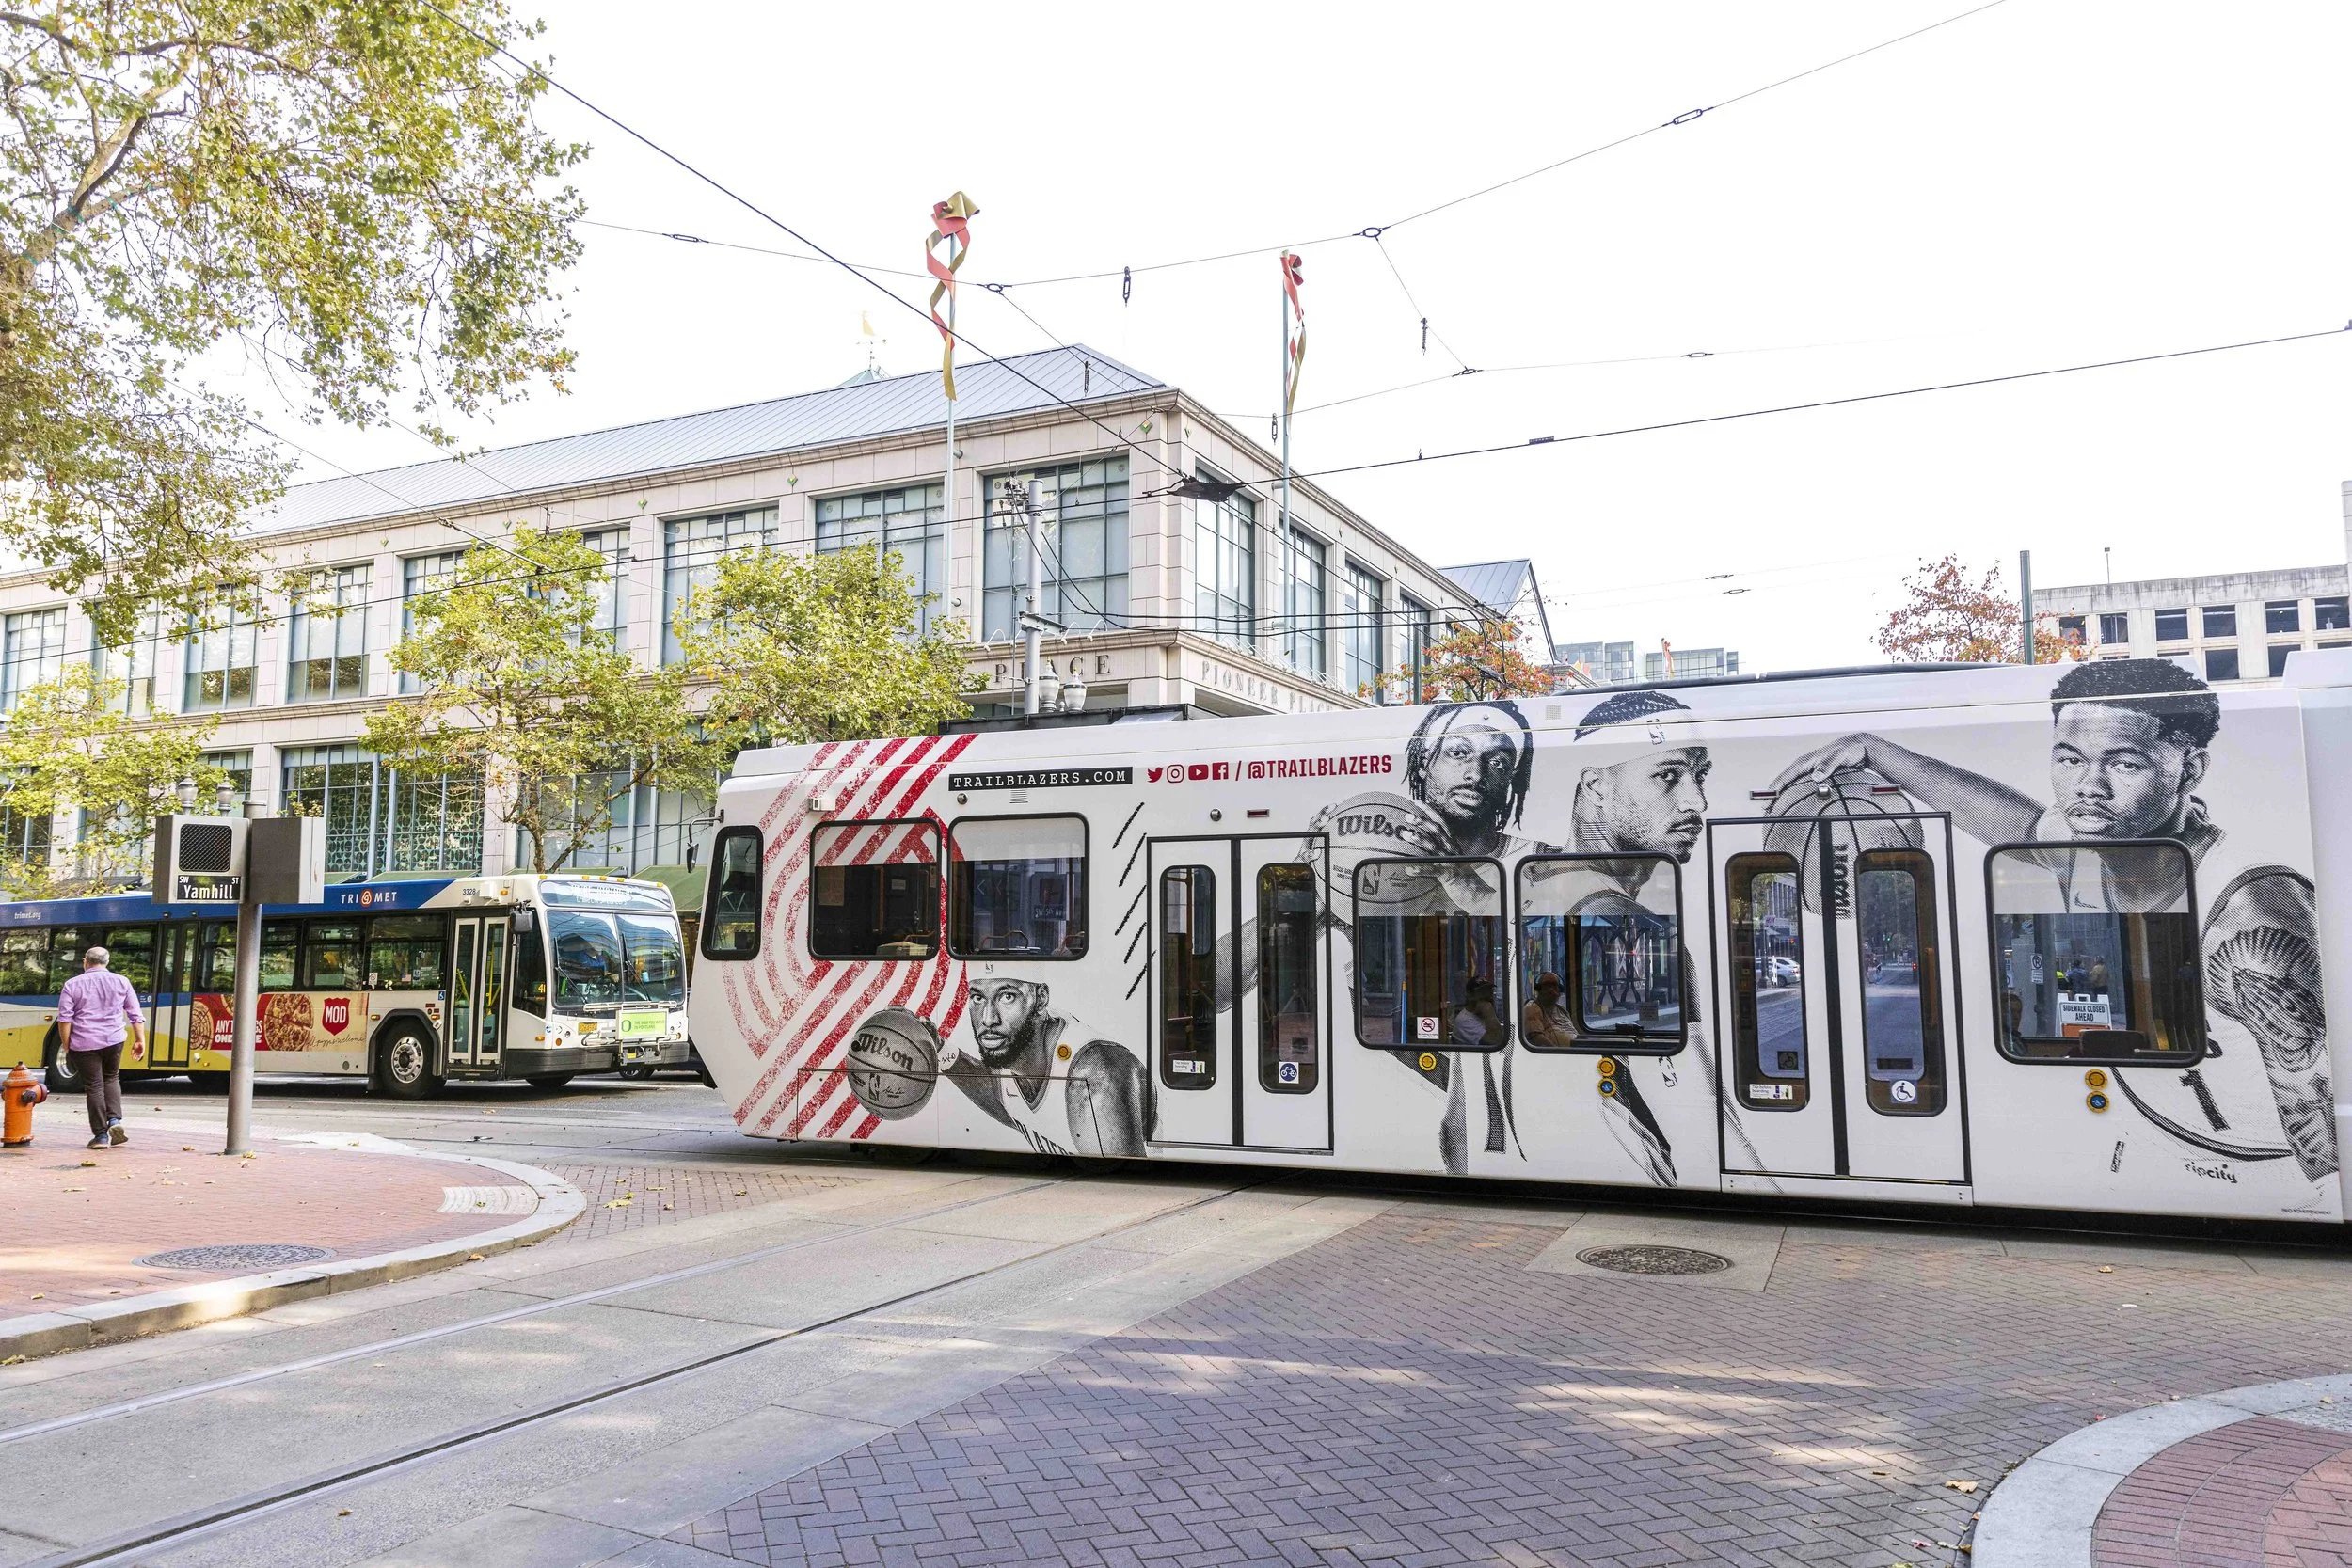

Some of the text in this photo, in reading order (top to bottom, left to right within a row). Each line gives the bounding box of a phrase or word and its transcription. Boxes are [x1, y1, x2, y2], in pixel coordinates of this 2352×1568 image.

[995, 654, 1110, 683] PCE
[1202, 660, 1279, 705] PIONEER
[1248, 754, 1391, 779] @TRAILBLAZERS
[953, 770, 1126, 788] TRAILBLAZERS.COM
[183, 884, 233, 899] Yamhill
[341, 892, 397, 904] TRI MET
[14, 911, 41, 920] trimet.org
[325, 1006, 347, 1023] MOD
[2063, 1004, 2106, 1014] SIDEWALK CLOSED
[2075, 1013, 2094, 1022] AHEAD
[215, 1020, 230, 1033] ANY
[851, 1033, 913, 1071] Wilson
